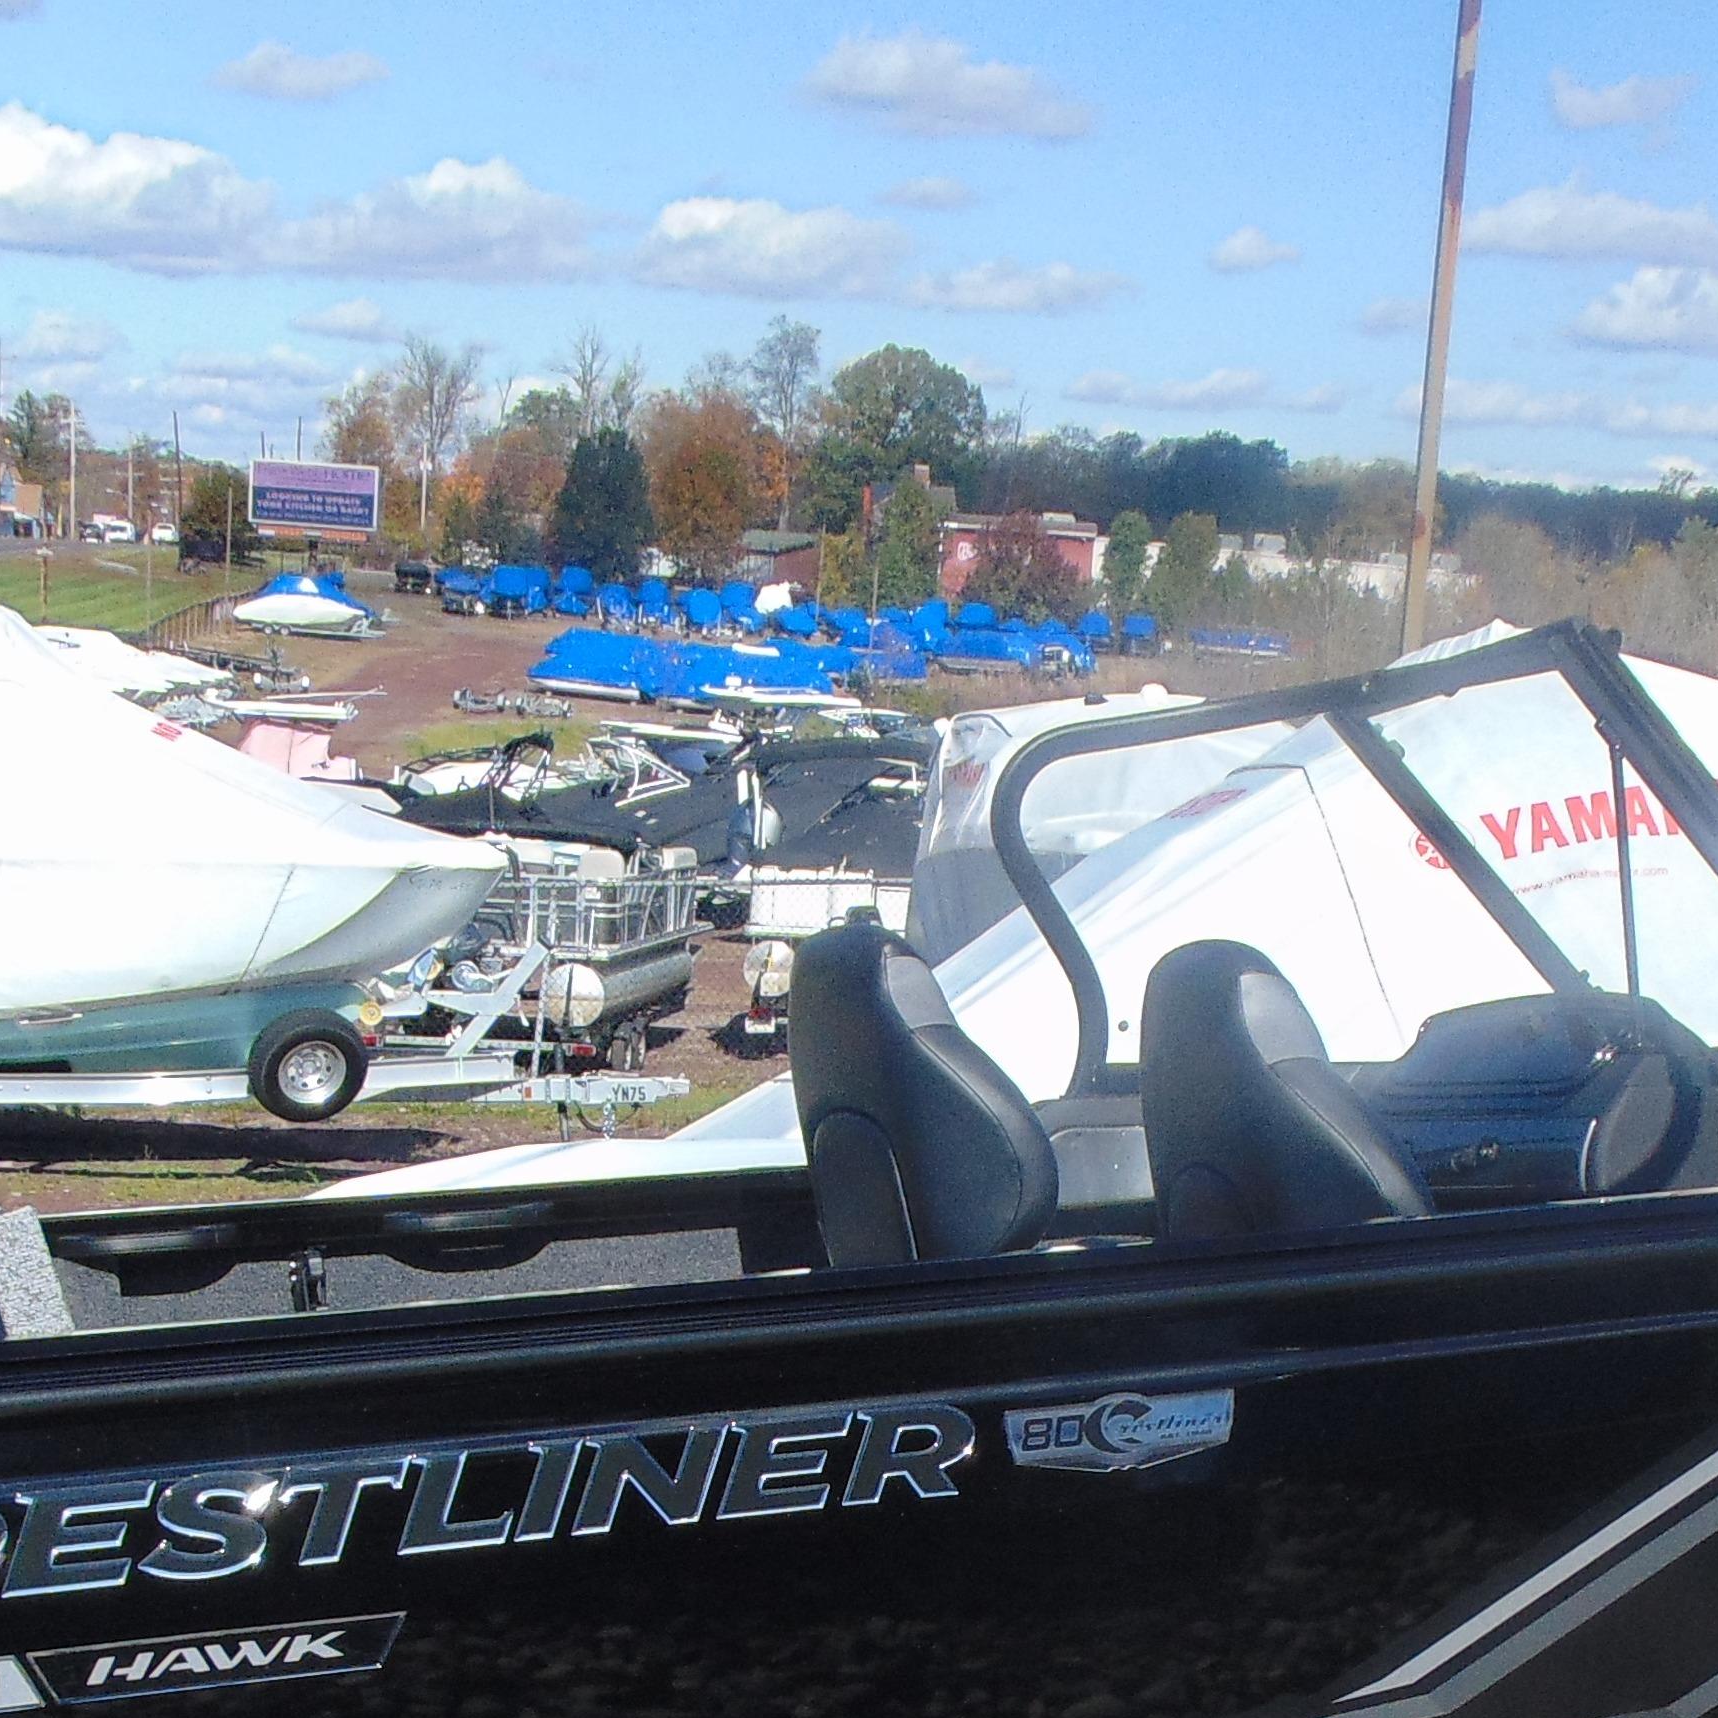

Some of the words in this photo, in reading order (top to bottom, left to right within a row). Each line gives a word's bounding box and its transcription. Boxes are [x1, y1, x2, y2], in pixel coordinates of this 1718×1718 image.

[611, 1083, 647, 1101] YN75
[1022, 1414, 1085, 1451] 80
[85, 1630, 347, 1687] HAWK
